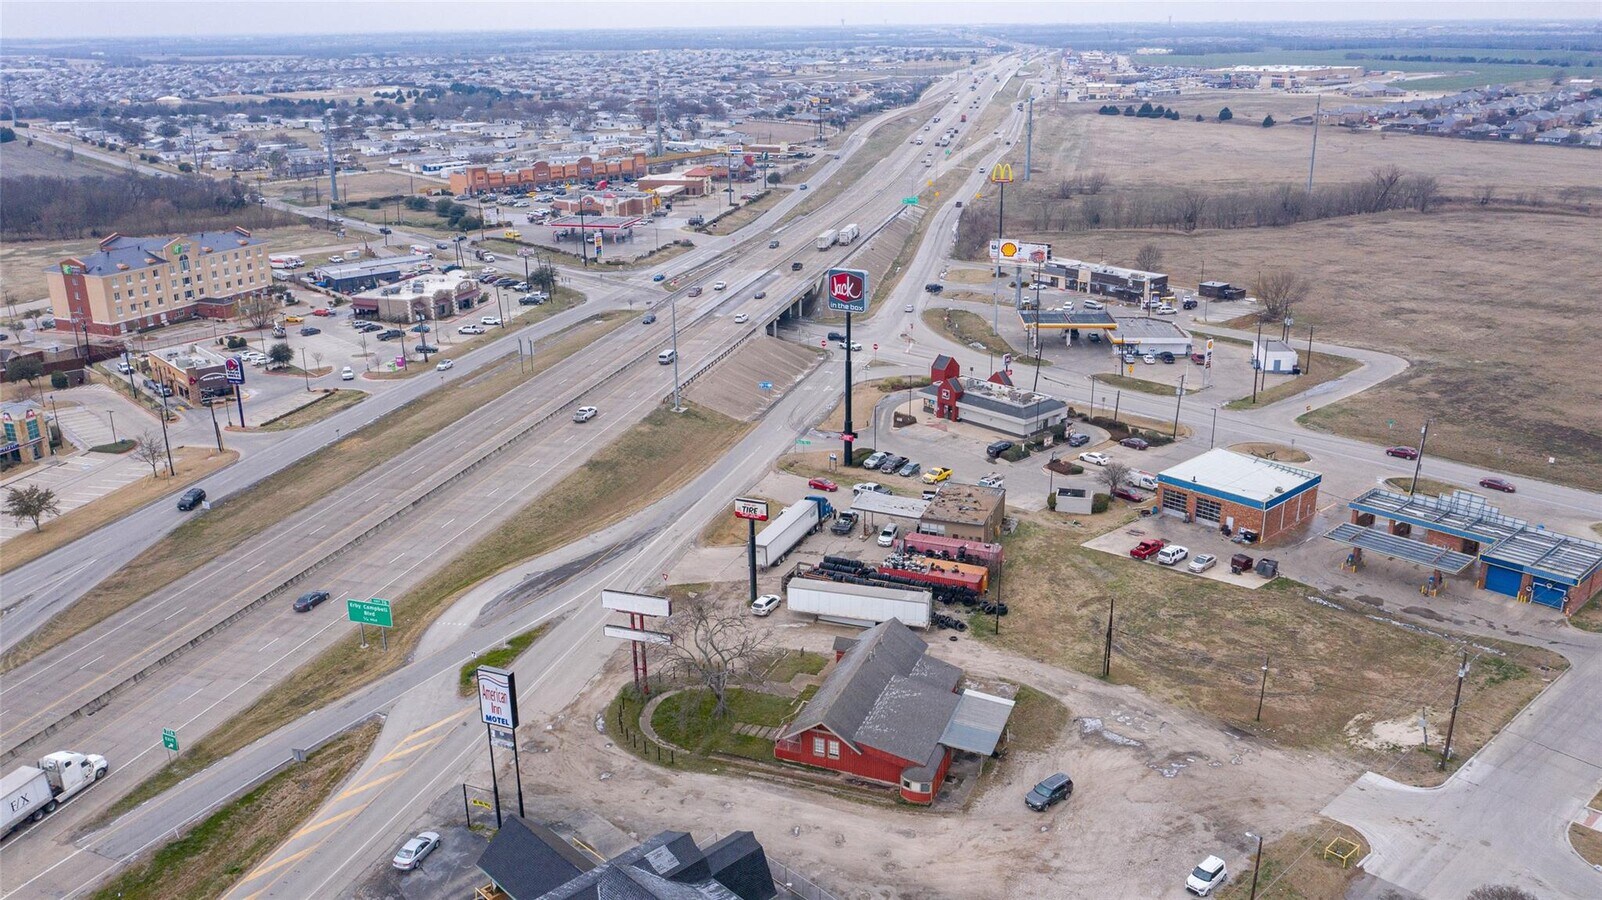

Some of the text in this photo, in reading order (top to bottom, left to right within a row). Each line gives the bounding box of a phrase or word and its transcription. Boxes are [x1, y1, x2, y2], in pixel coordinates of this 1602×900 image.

[831, 275, 862, 298] Jack
[741, 506, 758, 514] TIRE
[363, 604, 388, 613] Campbell
[482, 684, 508, 704] American
[490, 702, 502, 715] Inn
[485, 714, 510, 726] MOTEL
